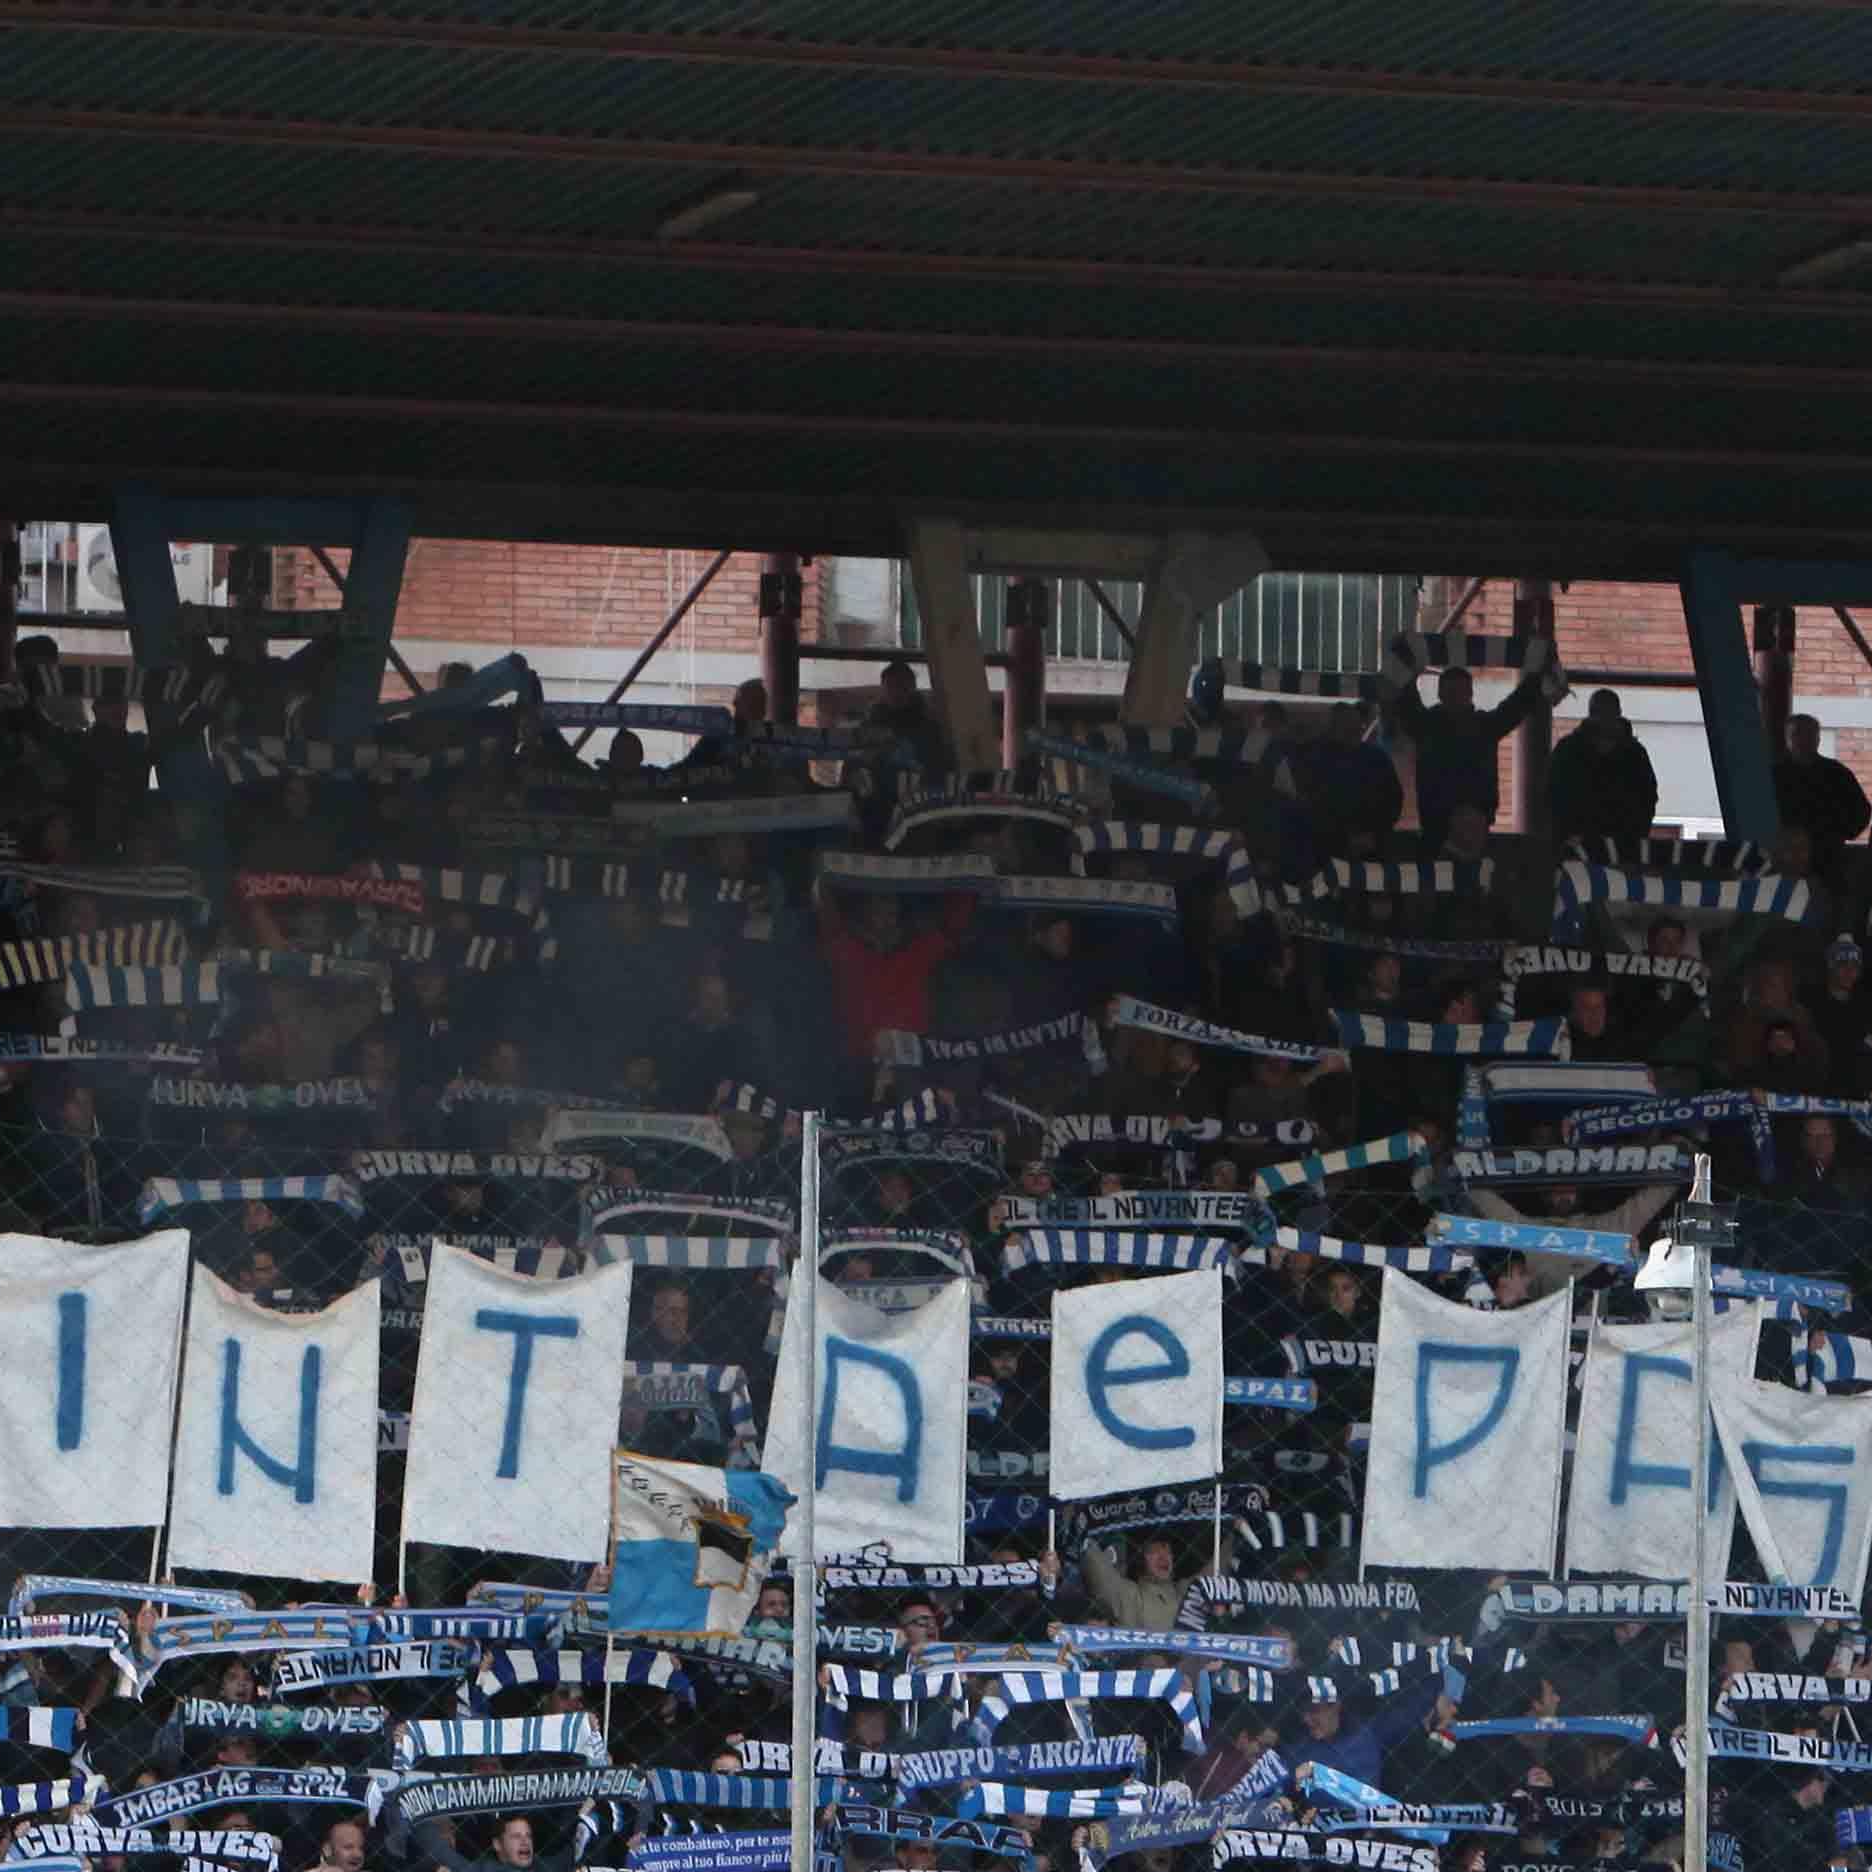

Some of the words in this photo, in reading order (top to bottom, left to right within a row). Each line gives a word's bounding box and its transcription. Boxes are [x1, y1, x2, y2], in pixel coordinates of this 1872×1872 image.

[1455, 1143, 1681, 1178] ALDAMAR
[1086, 1314, 1196, 1451] e
[1247, 1579, 1301, 1608] MODA
[1339, 1583, 1380, 1608] UNA
[896, 1745, 995, 1788] GRUPPO
[21, 1826, 156, 1856] CURVA
